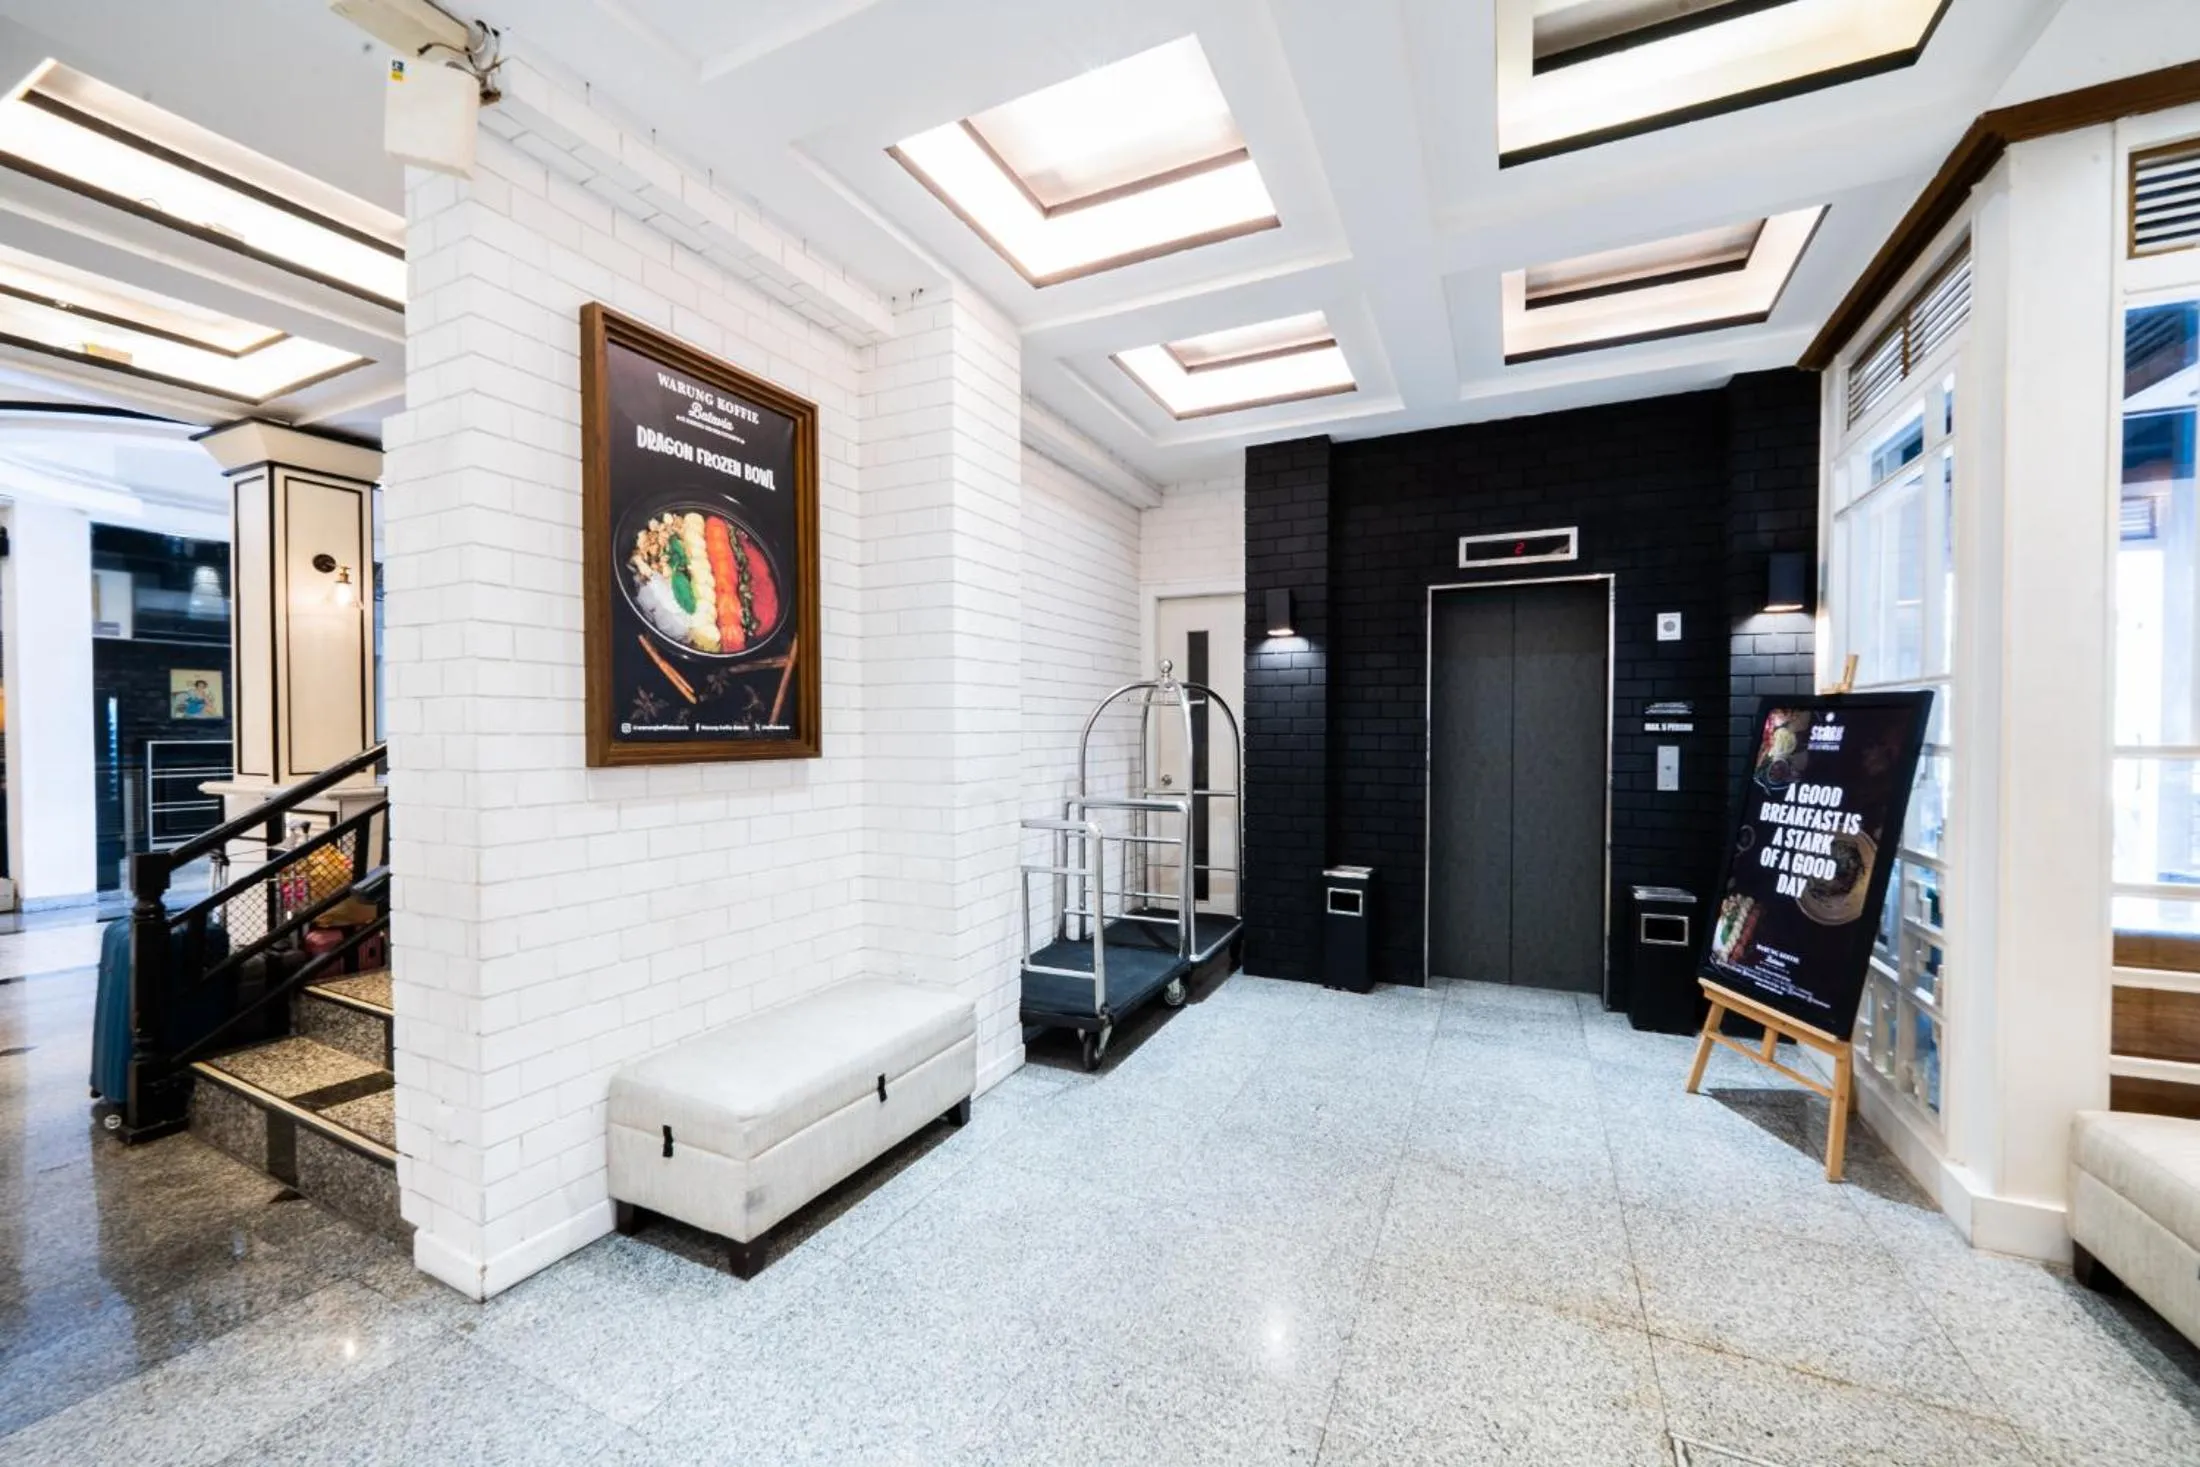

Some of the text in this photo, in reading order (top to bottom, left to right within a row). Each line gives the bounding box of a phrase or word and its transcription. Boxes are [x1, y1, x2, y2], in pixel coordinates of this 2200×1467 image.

[657, 371, 760, 425] WARUNG KOFFIE
[637, 424, 693, 461] DRAGON
[696, 447, 741, 478] FROZEN
[744, 463, 776, 491] BOWL
[1784, 783, 1843, 807] A GOOD
[1760, 802, 1862, 835] BREAKFAST IS
[1772, 827, 1835, 855] A STARK
[1760, 846, 1837, 880] OF A GOOD
[1776, 873, 1808, 898] DAY
